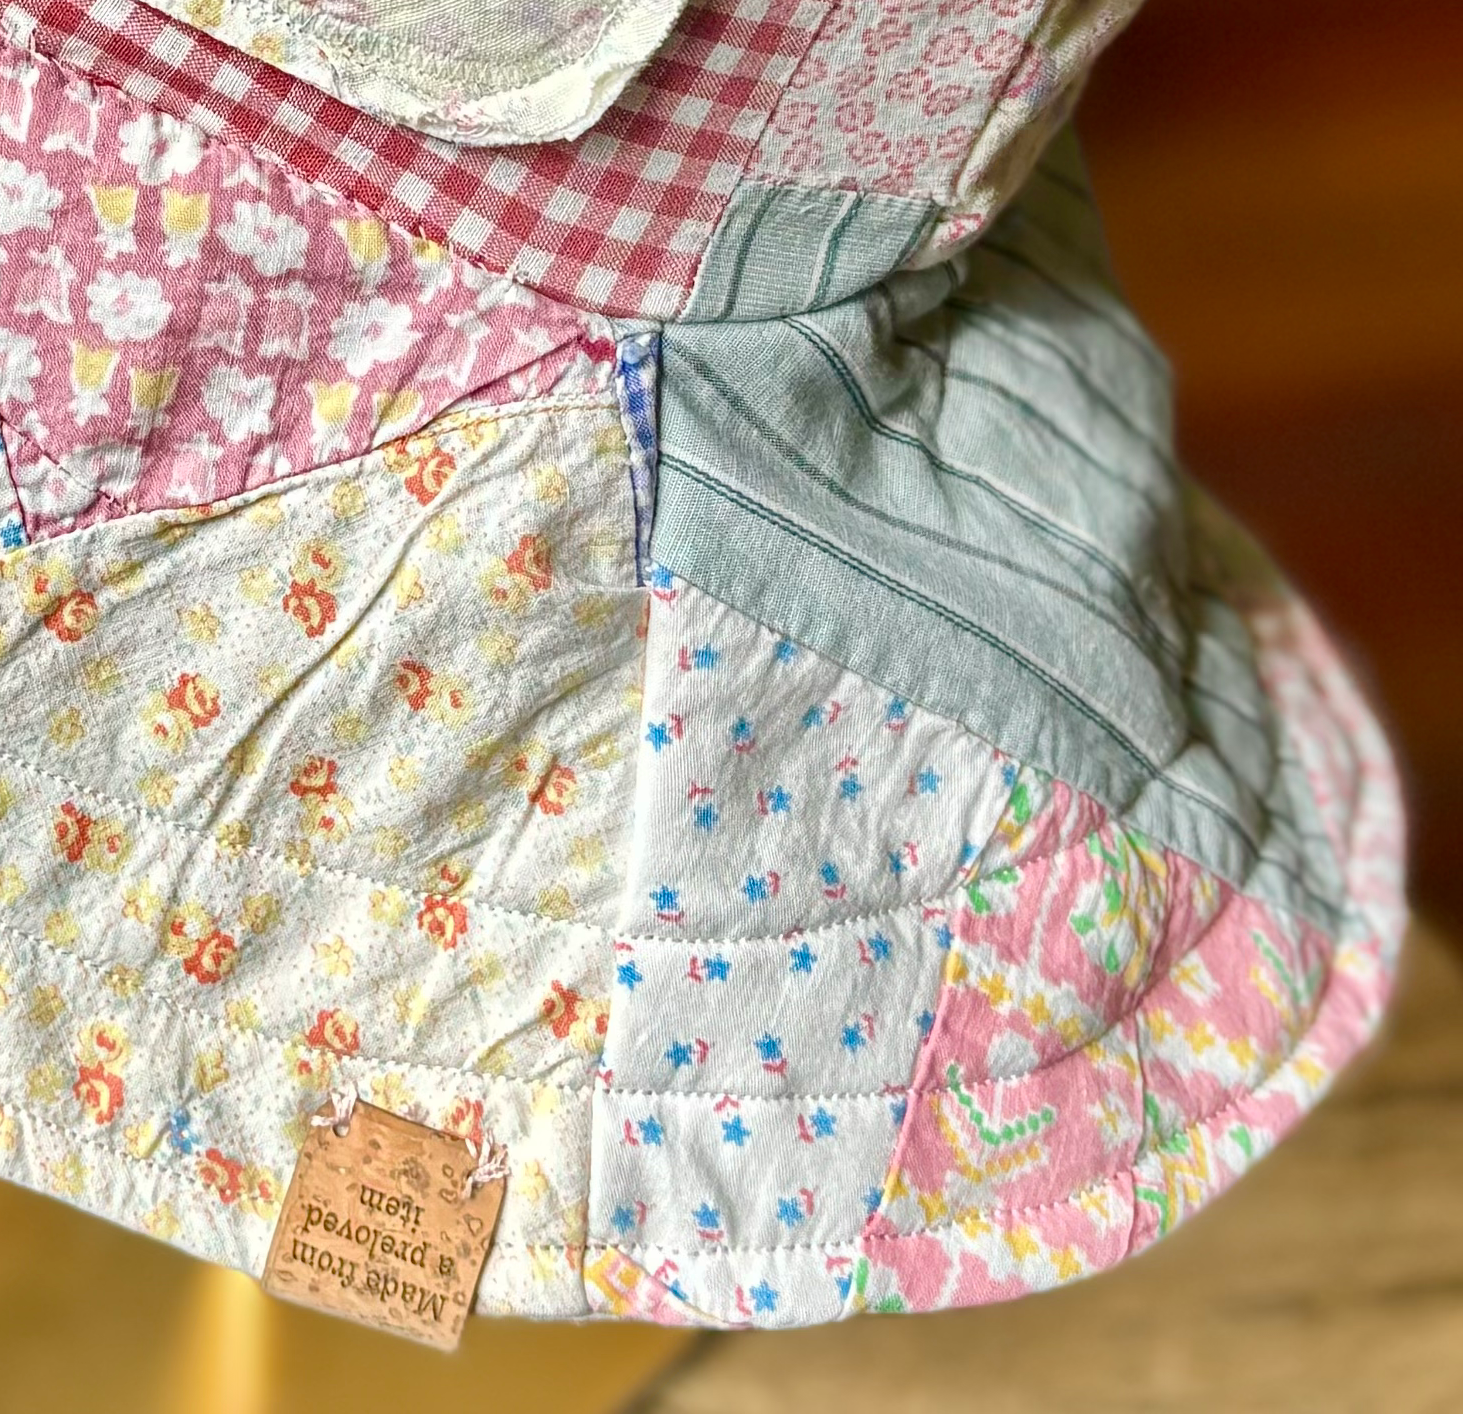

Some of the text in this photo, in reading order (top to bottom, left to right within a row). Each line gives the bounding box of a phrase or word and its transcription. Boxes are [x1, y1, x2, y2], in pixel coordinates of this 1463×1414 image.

[359, 1184, 426, 1234] item
[291, 1238, 449, 1322] Made from
[438, 1253, 456, 1276] a
